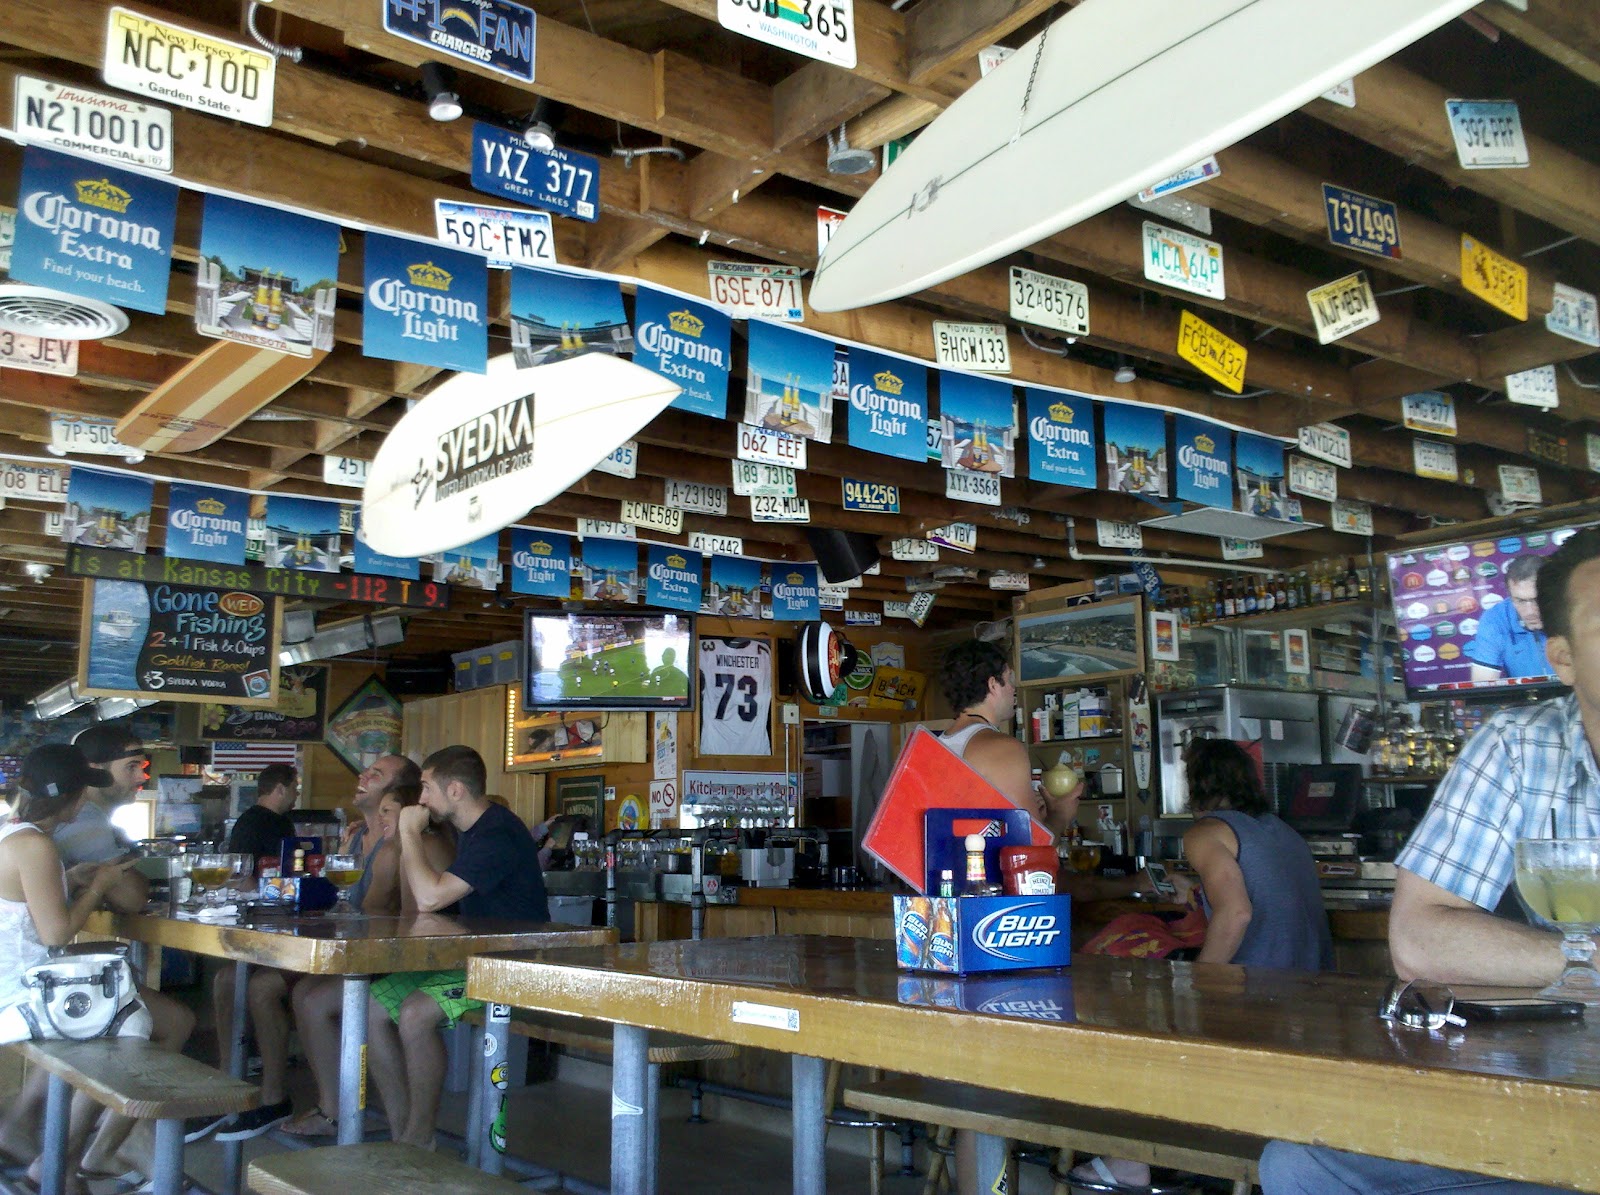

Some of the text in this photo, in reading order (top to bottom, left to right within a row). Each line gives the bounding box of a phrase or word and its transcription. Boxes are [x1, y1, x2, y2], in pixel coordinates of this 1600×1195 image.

[801, 0, 847, 43] 365
[153, 25, 236, 60] New Jersey
[431, 31, 493, 62] CHARGERS
[480, 11, 531, 63] FAN
[759, 21, 818, 50] WASHINGTON
[55, 88, 135, 114] Louisiana
[148, 82, 231, 113] Garden State
[26, 96, 164, 152] N210010
[53, 137, 138, 162] COMMERCIAL
[481, 138, 593, 202] YXZ 377
[504, 182, 570, 209] GREAT LAKES
[24, 191, 165, 254] Corona
[475, 207, 513, 221] TEXAS
[1328, 199, 1397, 246] 737499
[59, 229, 133, 271] Extra
[43, 257, 147, 294] Find your beach.
[712, 262, 755, 274] WISCONSIN
[1028, 273, 1070, 291] INDIANA
[368, 277, 481, 324] Corona
[401, 310, 460, 343] Light
[951, 325, 976, 334] IOWA
[225, 329, 287, 350] MINNESOTA
[637, 321, 726, 371] Corona
[659, 353, 705, 384] Extra
[850, 383, 923, 421] Corona
[870, 410, 908, 437] Light
[1030, 416, 1091, 446] Corona
[1046, 441, 1079, 462] Extra
[1178, 444, 1229, 476] Corona
[497, 457, 511, 477] OF
[1193, 467, 1220, 490] Light
[845, 482, 897, 506] 944256
[170, 508, 243, 535] Corona
[190, 529, 228, 548] Light
[72, 547, 101, 575] is
[118, 557, 147, 580] at
[163, 556, 251, 590] Kansas
[265, 567, 320, 600] City
[512, 550, 567, 572] Corona
[650, 562, 699, 584] Corona
[527, 567, 556, 583] Light
[660, 580, 689, 594] Extra
[153, 585, 260, 614] Gone WED
[773, 582, 817, 599] Corona
[786, 596, 809, 611] Light
[176, 612, 266, 642] Fishing
[193, 637, 220, 652] Fish
[221, 639, 235, 654] &
[235, 640, 266, 659] Chips
[715, 654, 760, 670] WINCHESTER
[143, 671, 227, 691] $3 SVEDKA VODKA
[715, 673, 759, 723] 73
[651, 790, 661, 804] NO
[566, 804, 594, 816] JAMESON
[1032, 877, 1049, 886] HEINZ
[906, 914, 929, 935] BUD
[998, 915, 1057, 933] BUD
[932, 936, 954, 951] BUD
[984, 930, 1060, 949] LIGHT
